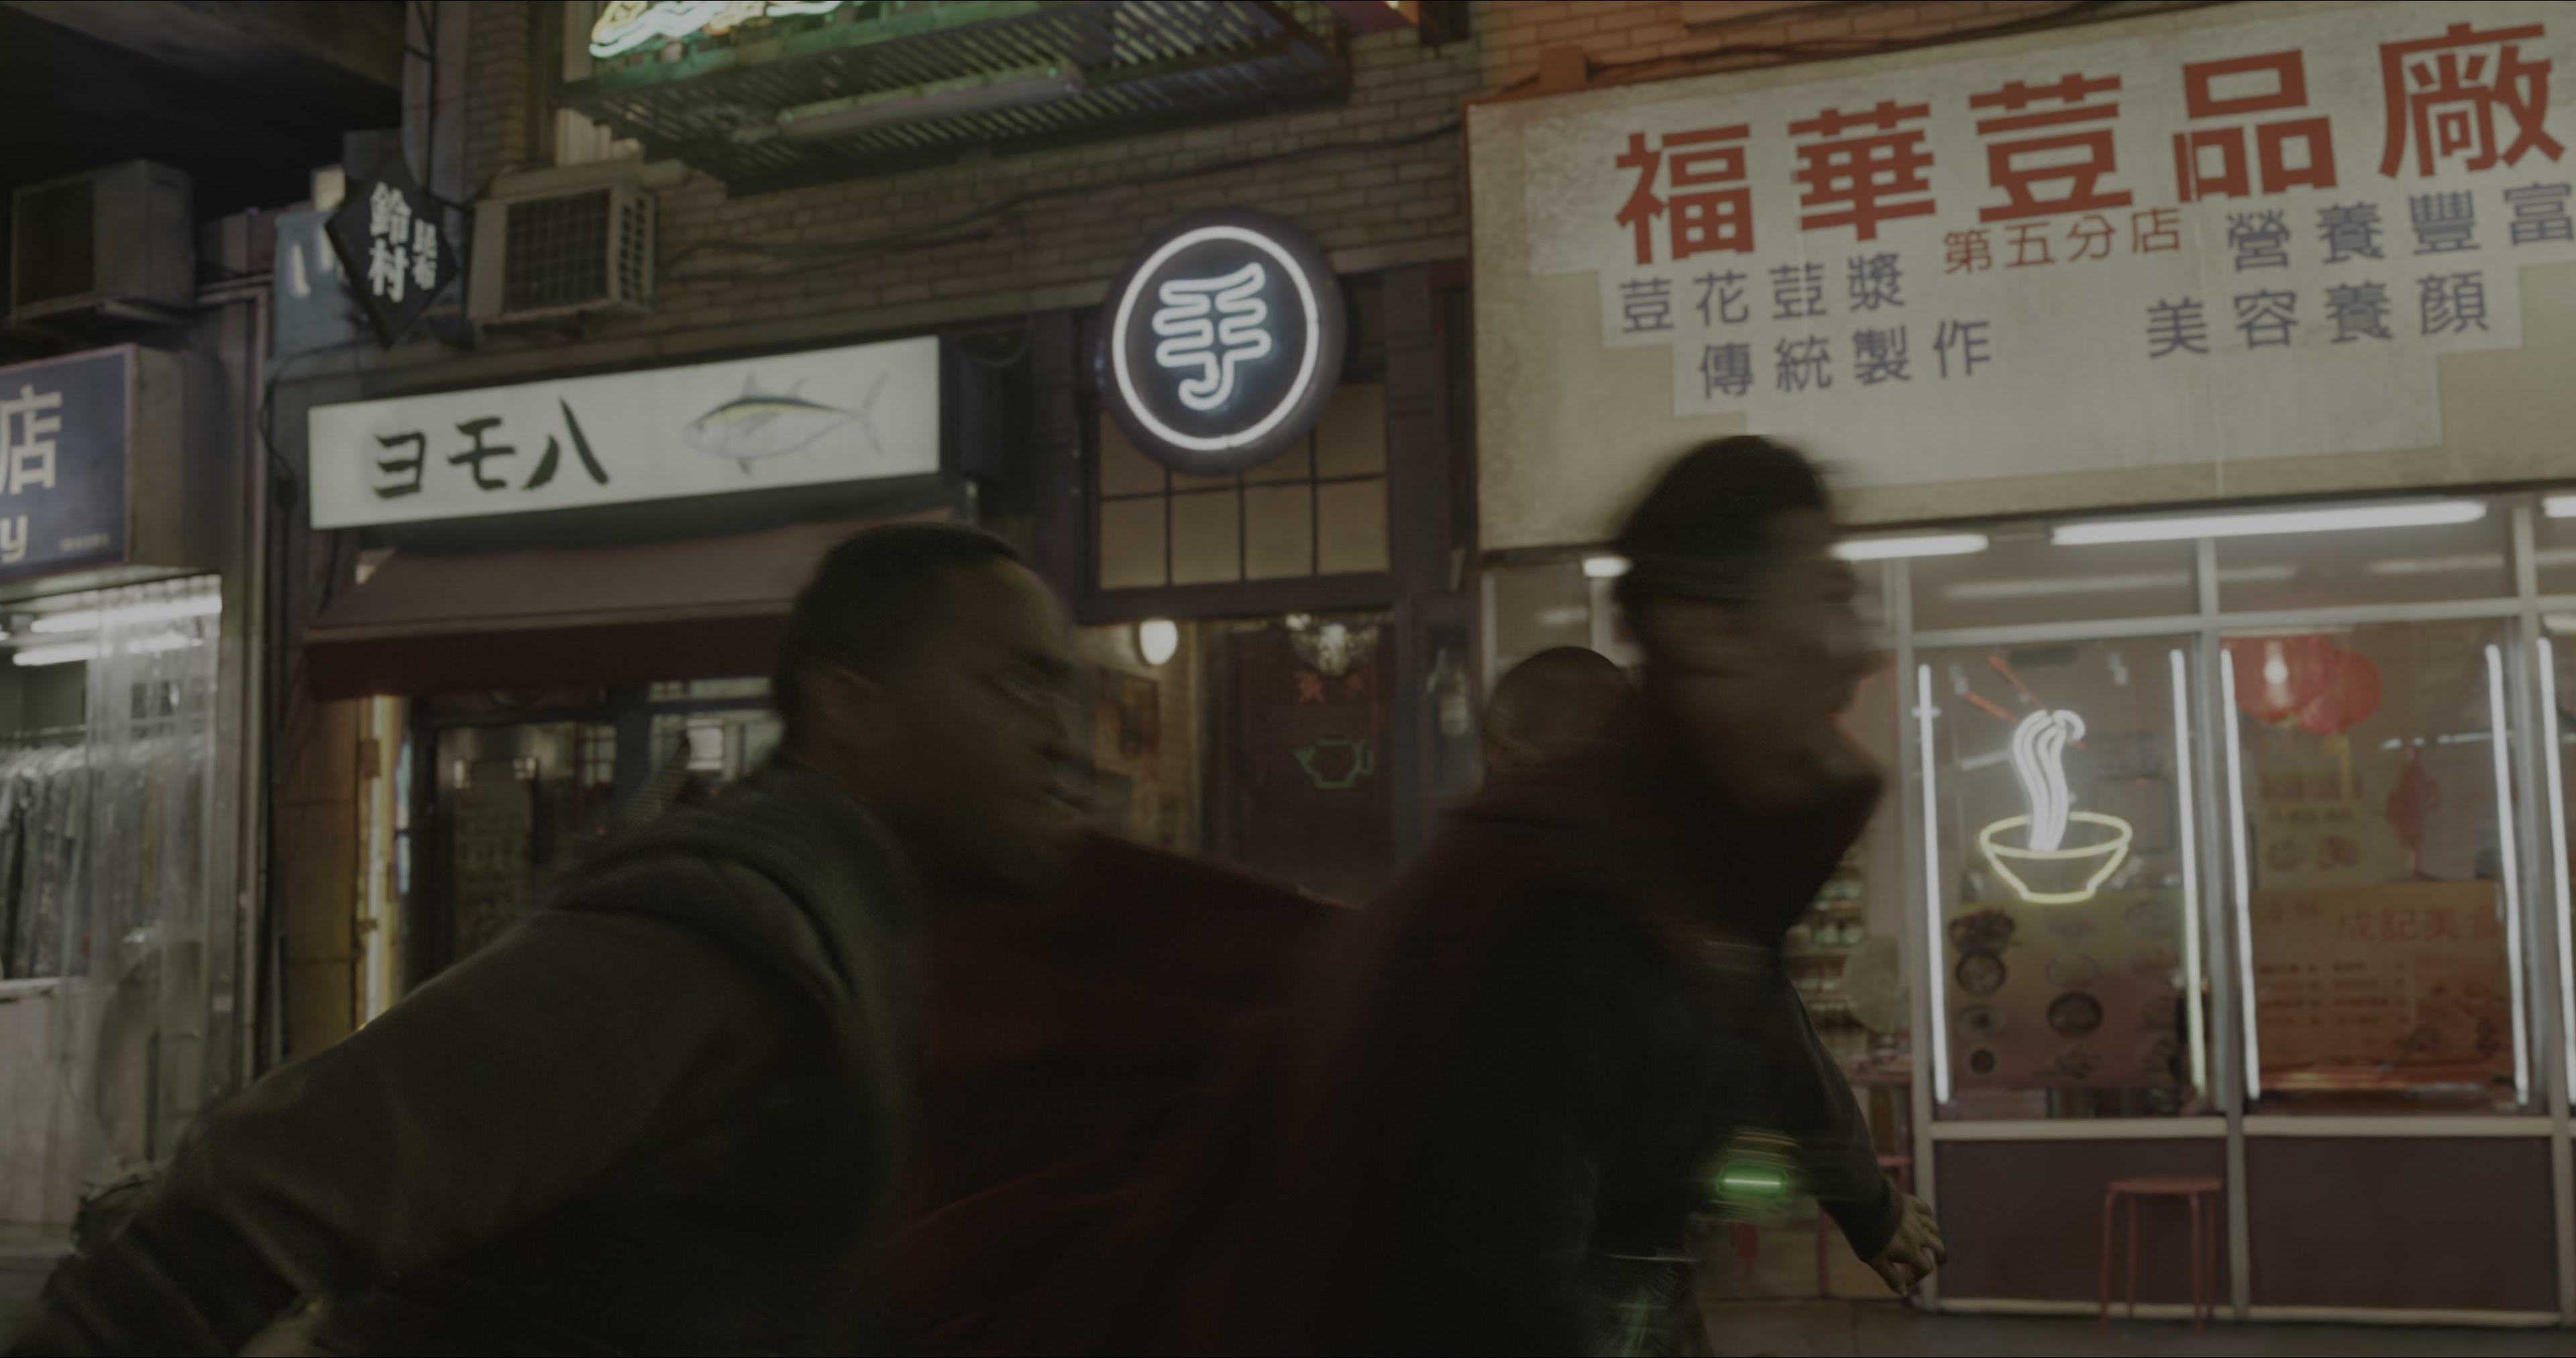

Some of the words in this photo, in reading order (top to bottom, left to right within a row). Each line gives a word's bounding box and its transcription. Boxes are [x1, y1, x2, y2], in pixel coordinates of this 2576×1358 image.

[1614, 22, 2566, 266] 福華荳品廠
[368, 180, 412, 303] 鈴村
[1943, 207, 2180, 274] 第五分店
[2226, 183, 2574, 271] 營養豐富
[1619, 253, 1905, 333] 荳花荳漿
[2146, 272, 2489, 359] 美容養顏
[1699, 319, 1991, 399] 傳統製作
[0, 383, 62, 496] 店
